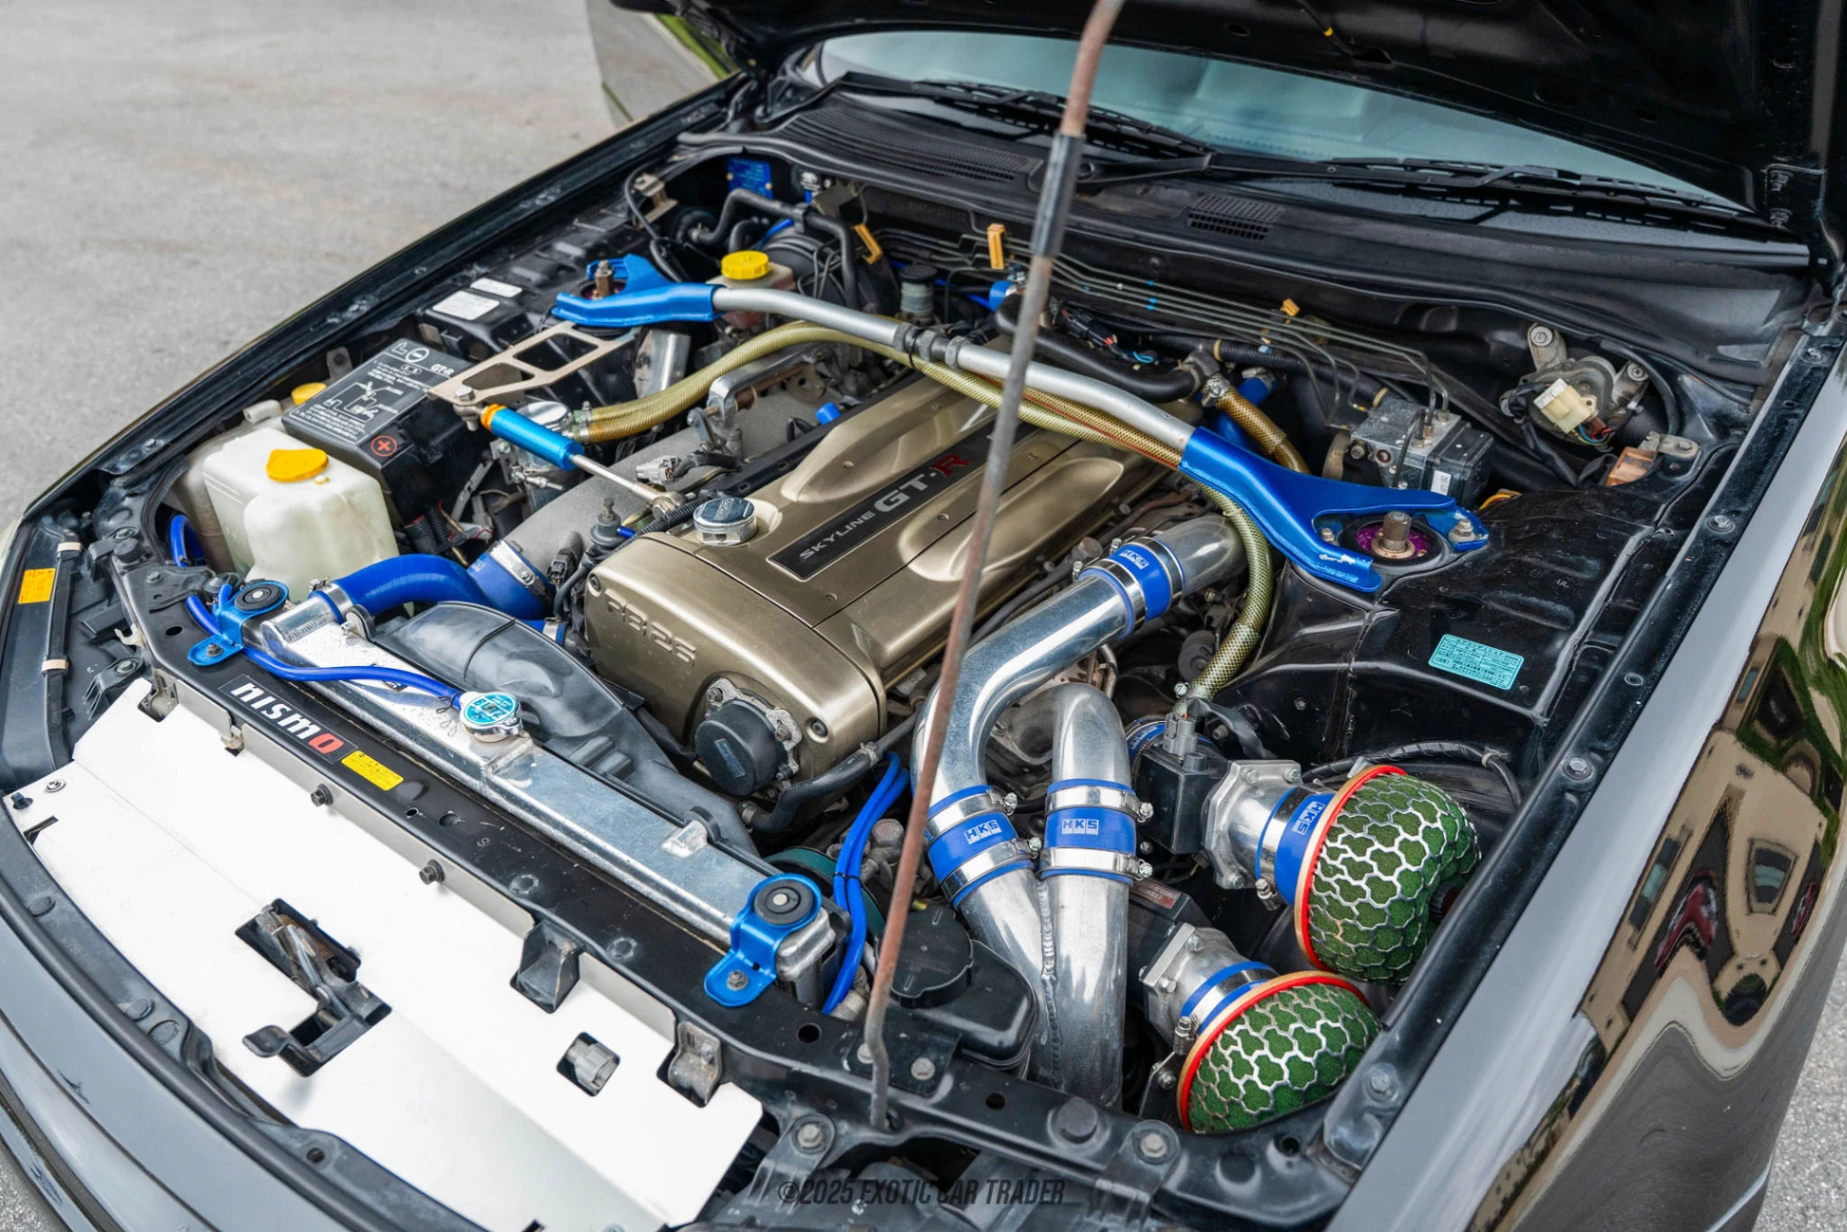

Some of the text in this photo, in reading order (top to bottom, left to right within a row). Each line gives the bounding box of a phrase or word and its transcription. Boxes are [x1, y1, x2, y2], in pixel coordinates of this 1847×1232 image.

[800, 453, 970, 559] SKYLINE GT-R
[1119, 549, 1149, 570] HKS
[231, 682, 345, 754] nismo
[964, 819, 1002, 845] HKS
[1061, 818, 1099, 836] HKS
[1292, 801, 1326, 836] HKS
